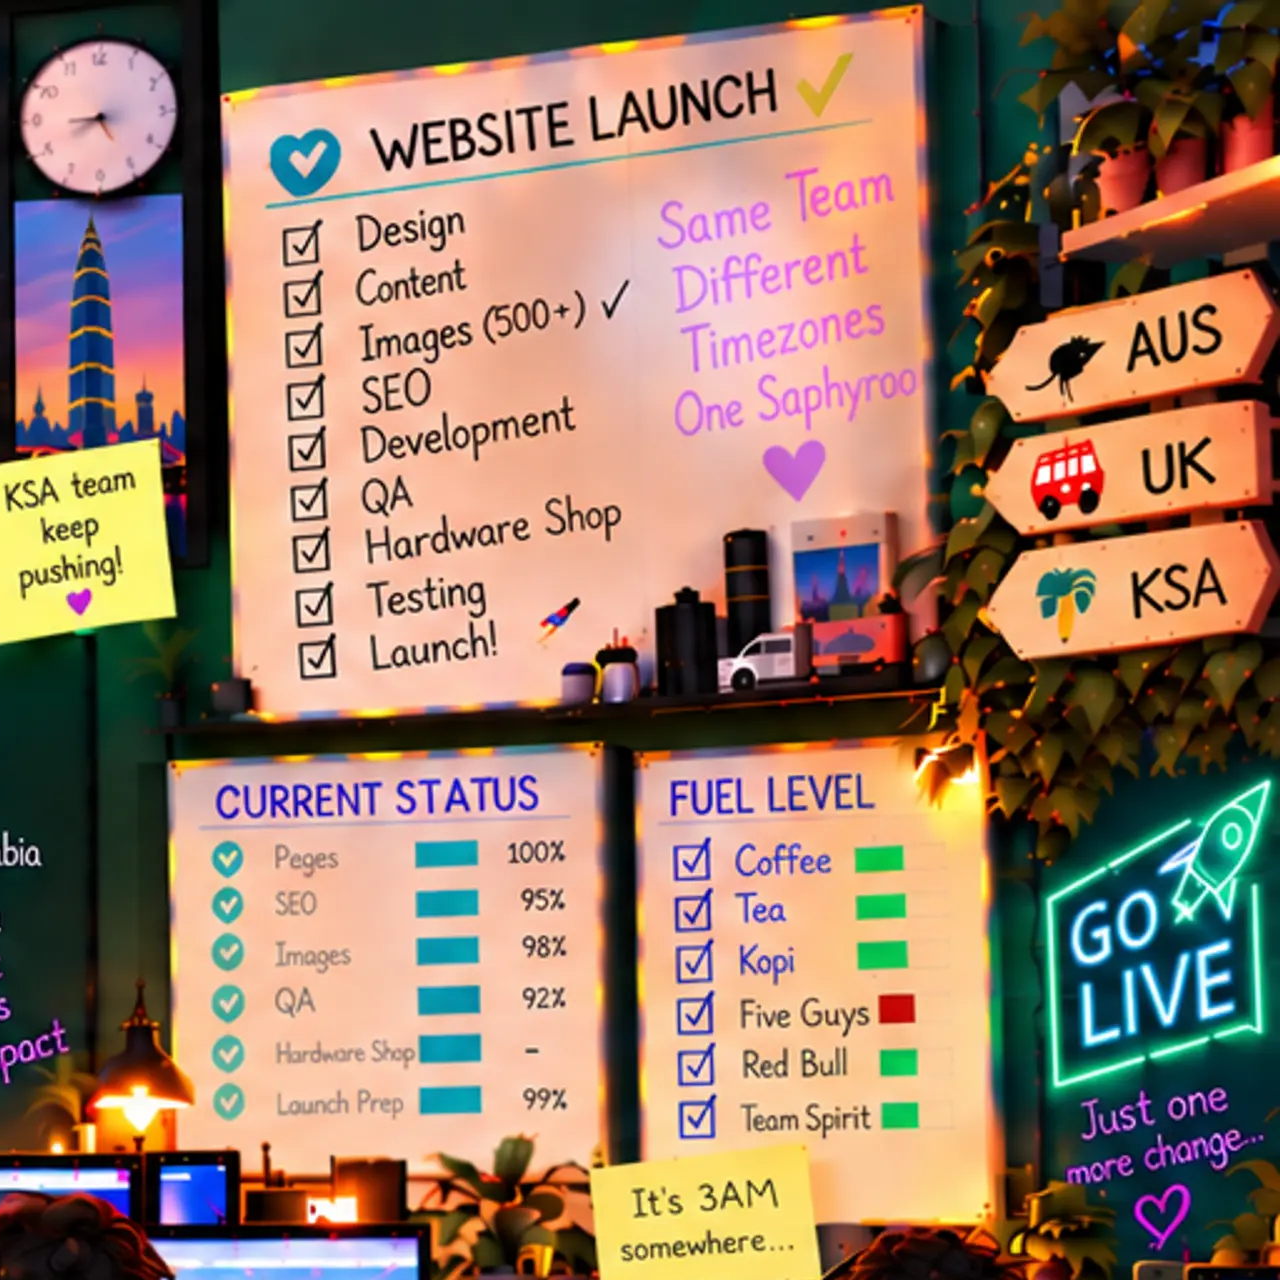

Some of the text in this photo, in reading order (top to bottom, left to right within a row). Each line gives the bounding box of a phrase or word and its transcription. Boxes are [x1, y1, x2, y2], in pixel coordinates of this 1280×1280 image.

[370, 68, 776, 175] WEBSITE LAUNCH
[657, 168, 894, 249] Same Team
[356, 210, 464, 252] Design
[356, 259, 466, 306] Content
[673, 234, 868, 313] Different
[360, 290, 585, 364] Images (500+)
[680, 304, 884, 372] Timezones
[1127, 304, 1222, 372] AUS
[363, 368, 431, 414] SEO
[675, 362, 918, 436] One Saphyroo
[361, 396, 576, 463] Development
[1142, 437, 1216, 494] UK
[5, 472, 136, 511] KSA team
[362, 476, 413, 517] QA
[40, 518, 99, 547] keep
[366, 495, 621, 564] Hardware Shop
[19, 545, 123, 599] pushing!
[1132, 558, 1227, 619] KSA
[367, 578, 486, 618] Testing
[370, 620, 496, 670] Launch!
[216, 775, 538, 819] CURRENT STATUS
[671, 774, 874, 816] FUEL LEVEL
[509, 841, 565, 863] 100%
[735, 843, 831, 876] Coffee
[276, 888, 565, 916] SEO 95%
[735, 892, 786, 923] Tea
[1072, 891, 1157, 965] GO
[276, 935, 566, 974] Images 98%
[740, 944, 794, 985] Kopi
[275, 987, 565, 1018] QA 92%
[1083, 941, 1233, 1045] LIVE
[741, 998, 870, 1037] Five Guys
[743, 1047, 847, 1078] Red Bull
[523, 1088, 567, 1110] 99%
[741, 1103, 871, 1139] Team Spirit
[1082, 1088, 1228, 1140] Just one
[632, 1179, 778, 1218] It's 3AM
